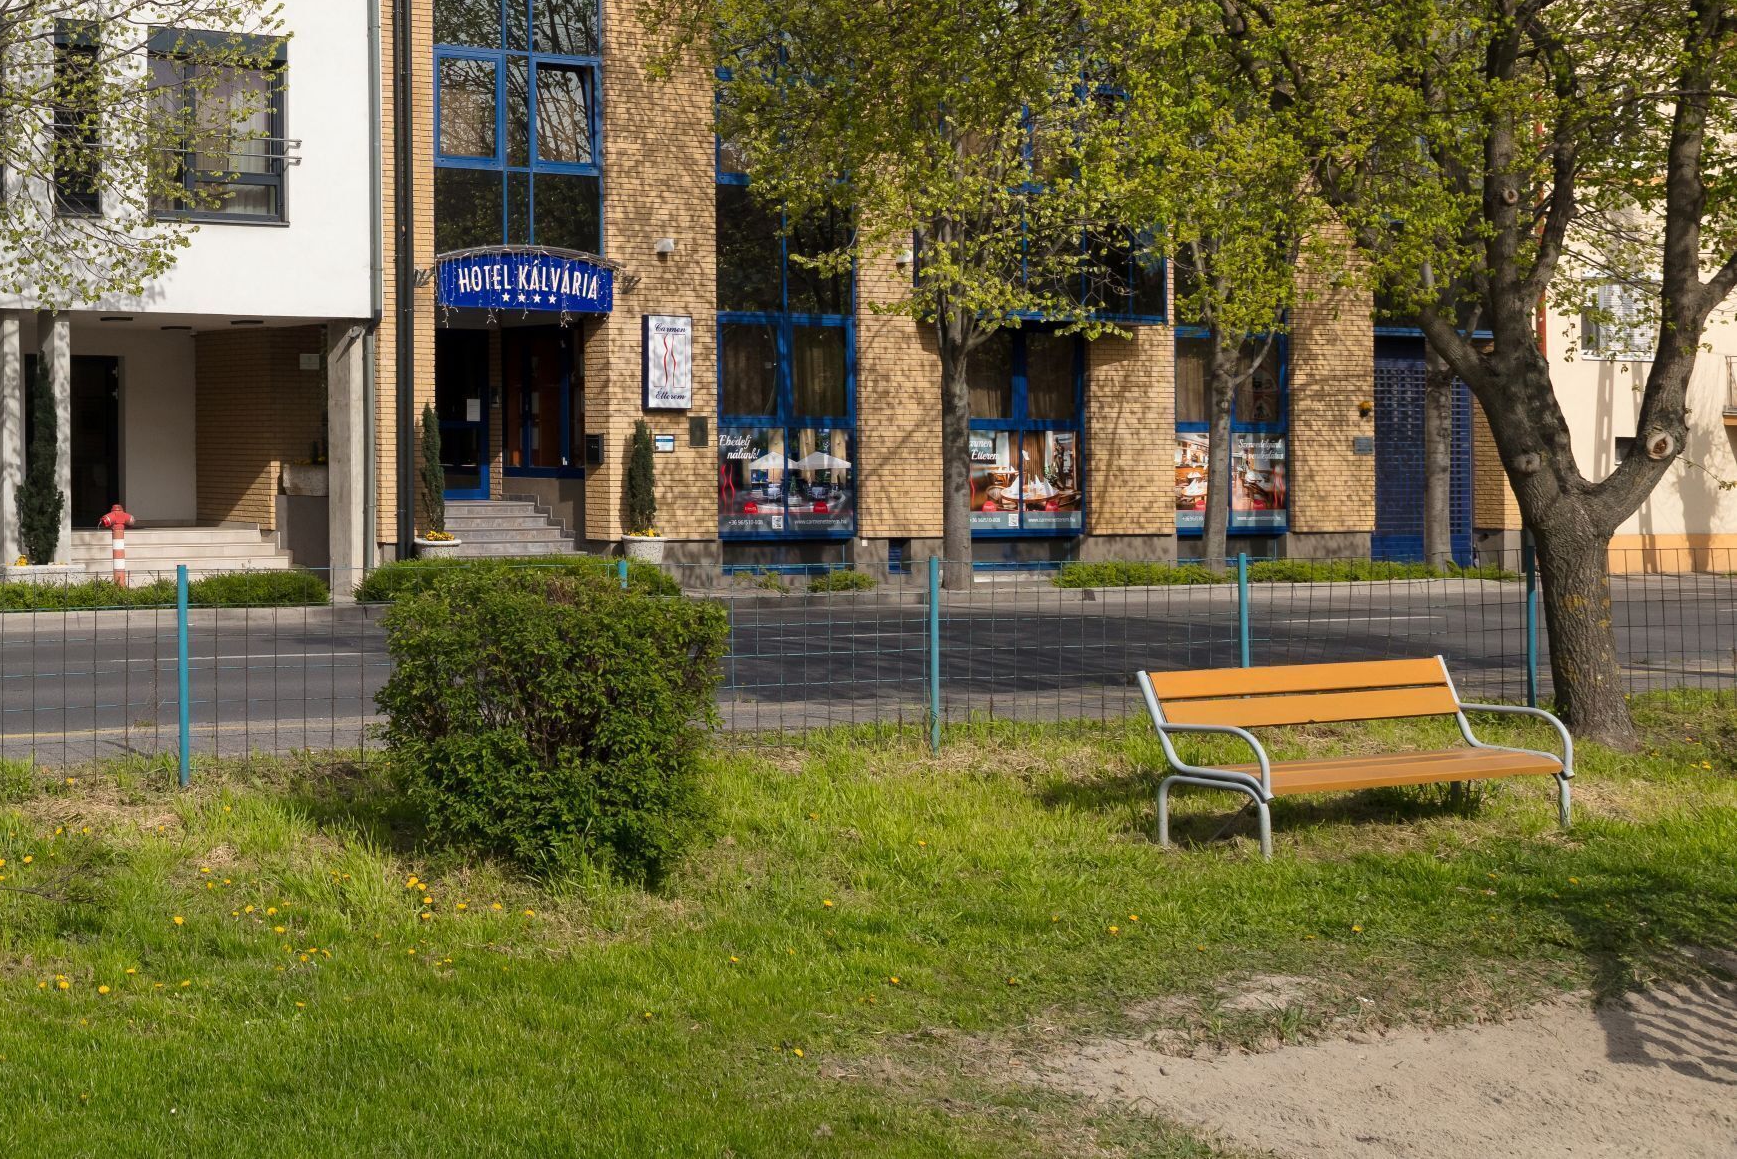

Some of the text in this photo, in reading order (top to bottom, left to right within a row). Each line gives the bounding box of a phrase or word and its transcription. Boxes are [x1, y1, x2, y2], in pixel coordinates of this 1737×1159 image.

[458, 260, 598, 300] HOTEL KÁLVÁRIA
[654, 323, 686, 333] Carmen
[655, 388, 686, 400] Étterem
[719, 434, 752, 449] Ebédelj
[727, 447, 760, 459] nálunk!
